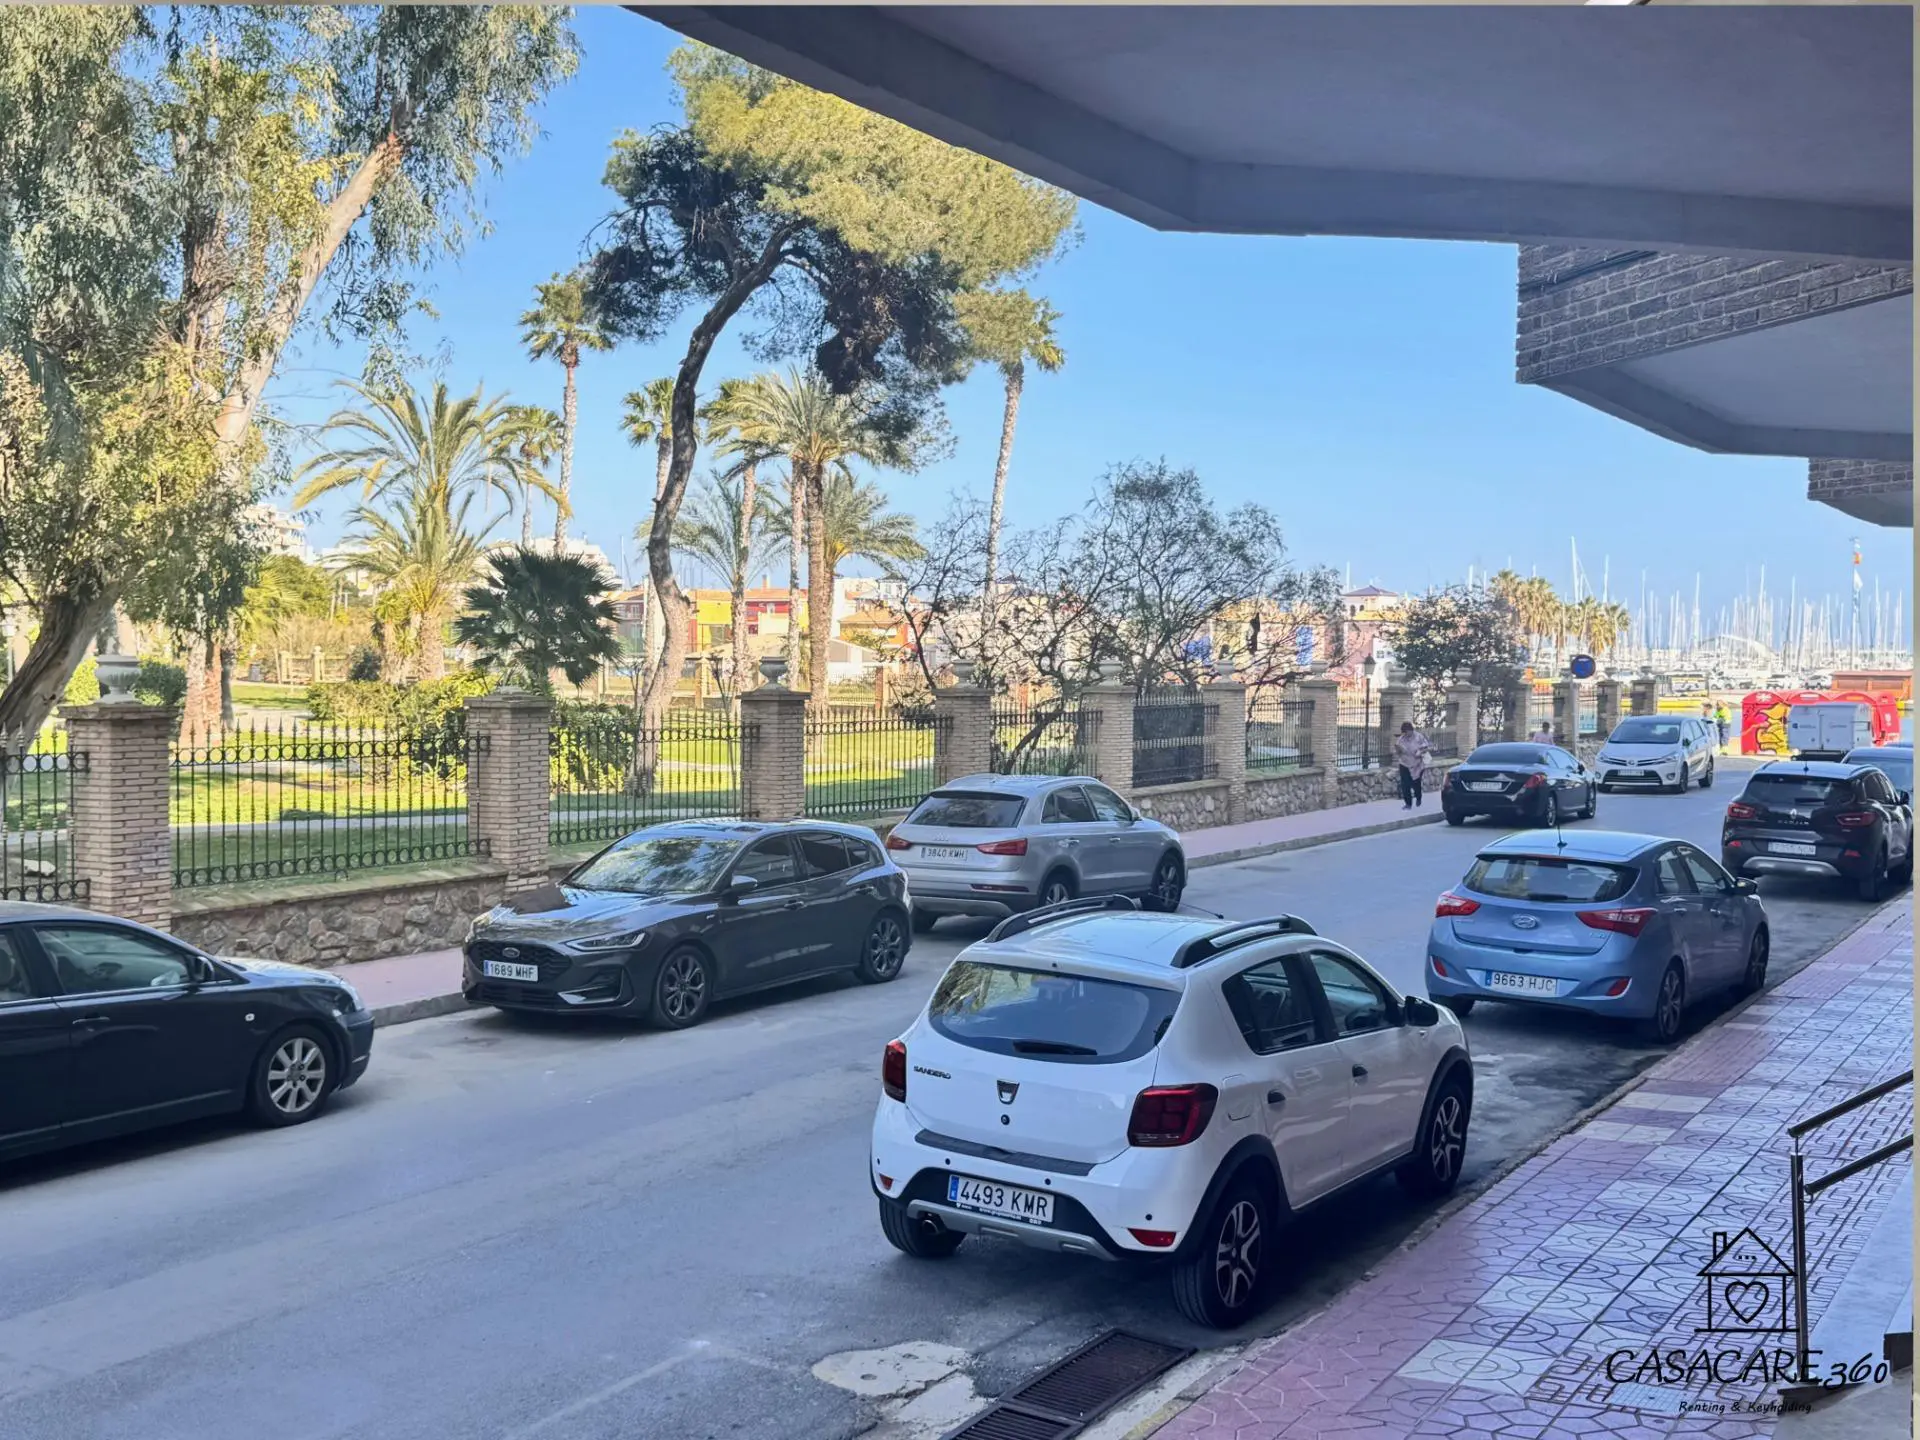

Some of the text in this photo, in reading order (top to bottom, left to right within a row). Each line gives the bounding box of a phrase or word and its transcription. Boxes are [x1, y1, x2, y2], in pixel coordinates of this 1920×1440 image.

[490, 963, 535, 979] 1689 MHF
[1493, 973, 1553, 992] 9663 HJC
[913, 1065, 952, 1080] SANDERO
[960, 1181, 1004, 1207] 4493
[1011, 1191, 1048, 1217] KMR
